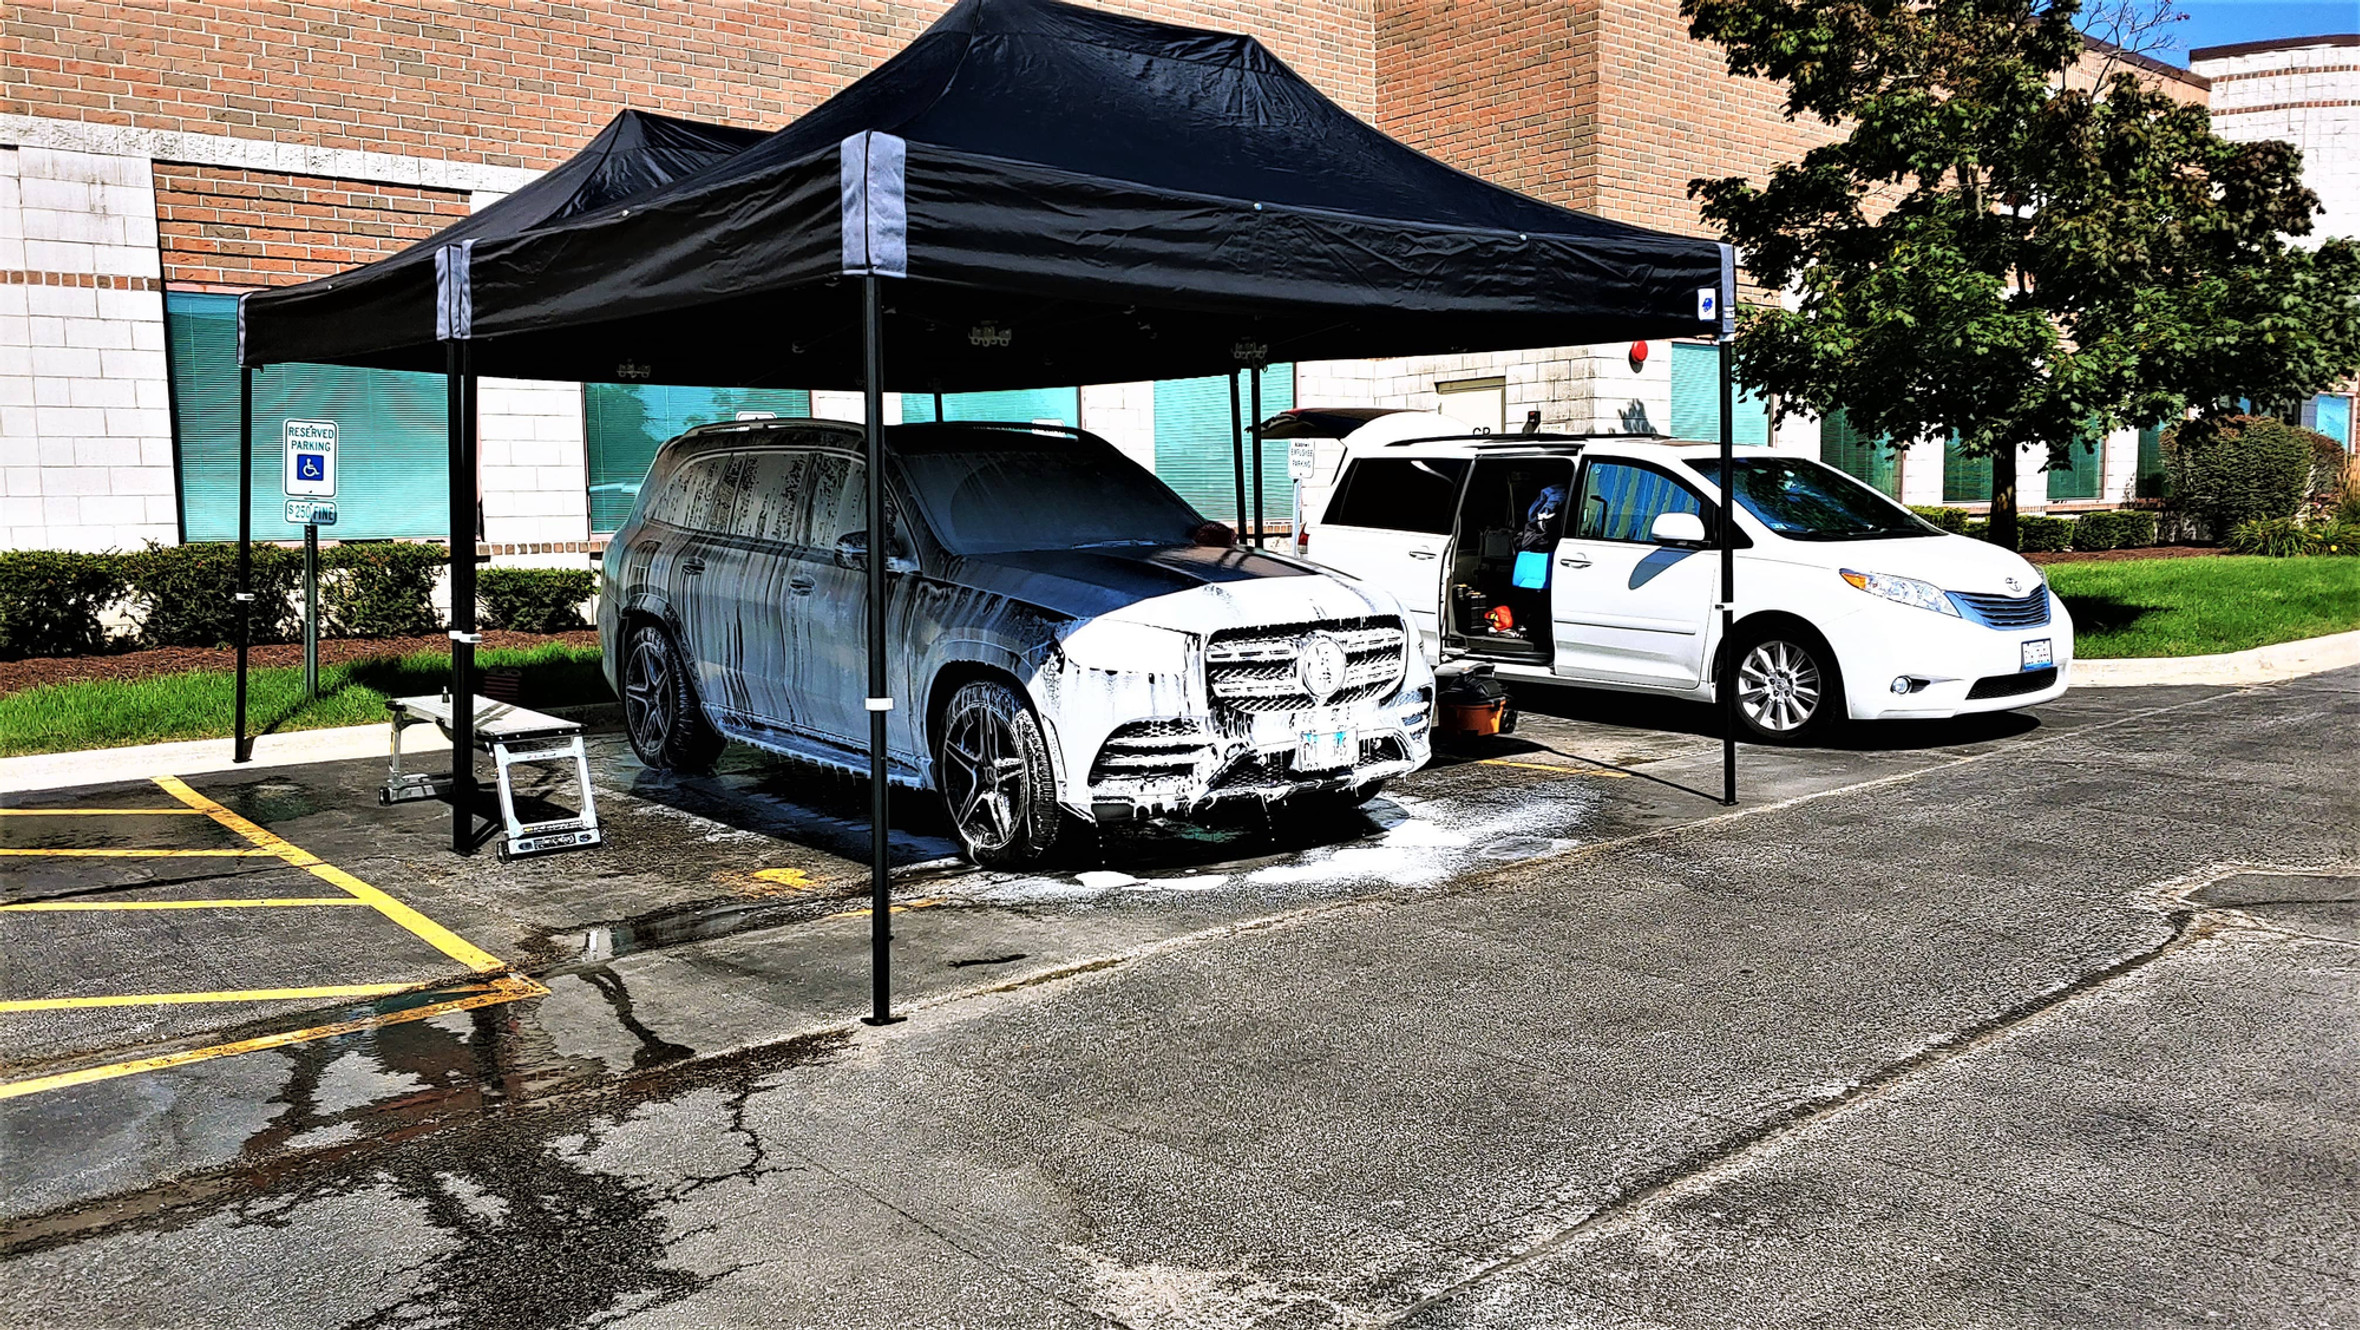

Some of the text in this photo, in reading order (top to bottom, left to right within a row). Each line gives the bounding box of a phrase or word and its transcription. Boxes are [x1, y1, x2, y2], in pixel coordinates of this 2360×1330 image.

[288, 426, 334, 439] RESERVED
[291, 440, 331, 451] PARKING
[313, 506, 334, 520] FINE
